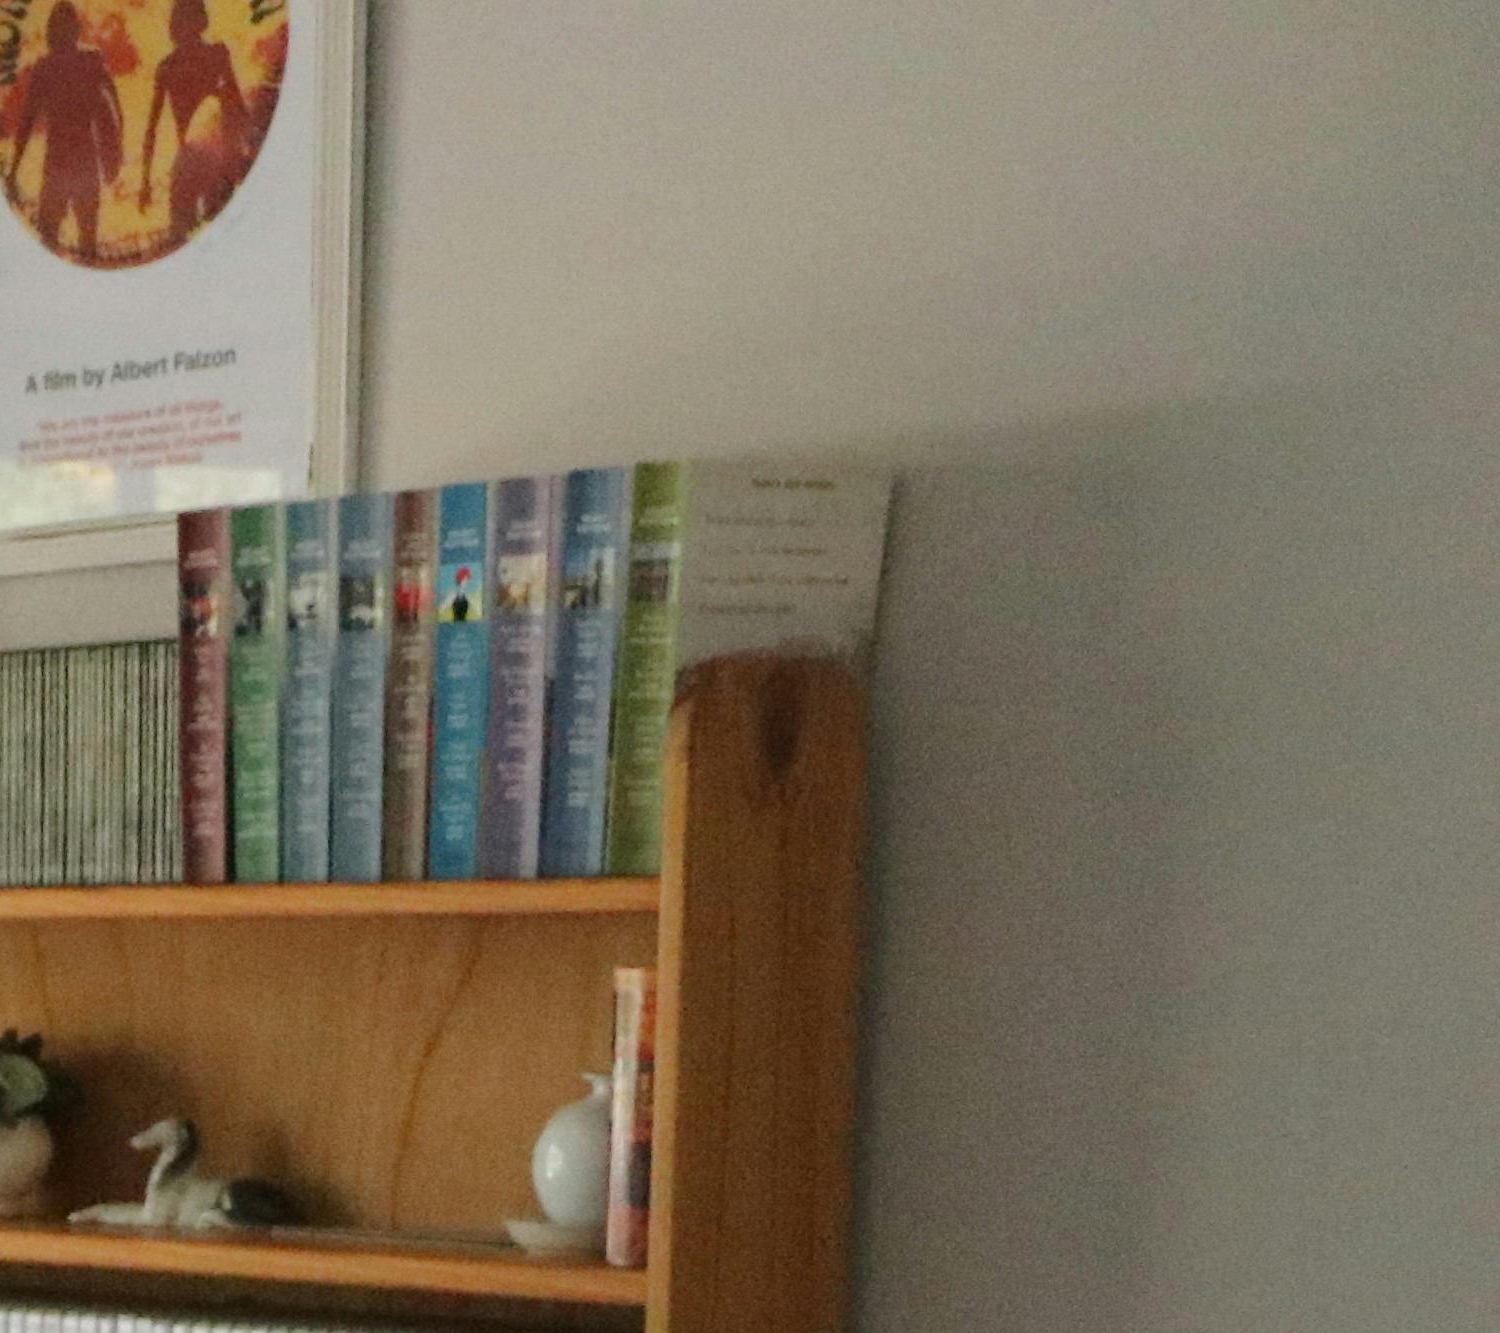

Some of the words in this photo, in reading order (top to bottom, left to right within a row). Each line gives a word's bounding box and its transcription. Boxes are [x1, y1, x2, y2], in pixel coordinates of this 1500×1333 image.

[25, 373, 38, 394] A
[43, 369, 77, 390] film
[82, 363, 106, 389] by
[110, 356, 169, 383] Albert
[173, 348, 237, 373] Falzon
